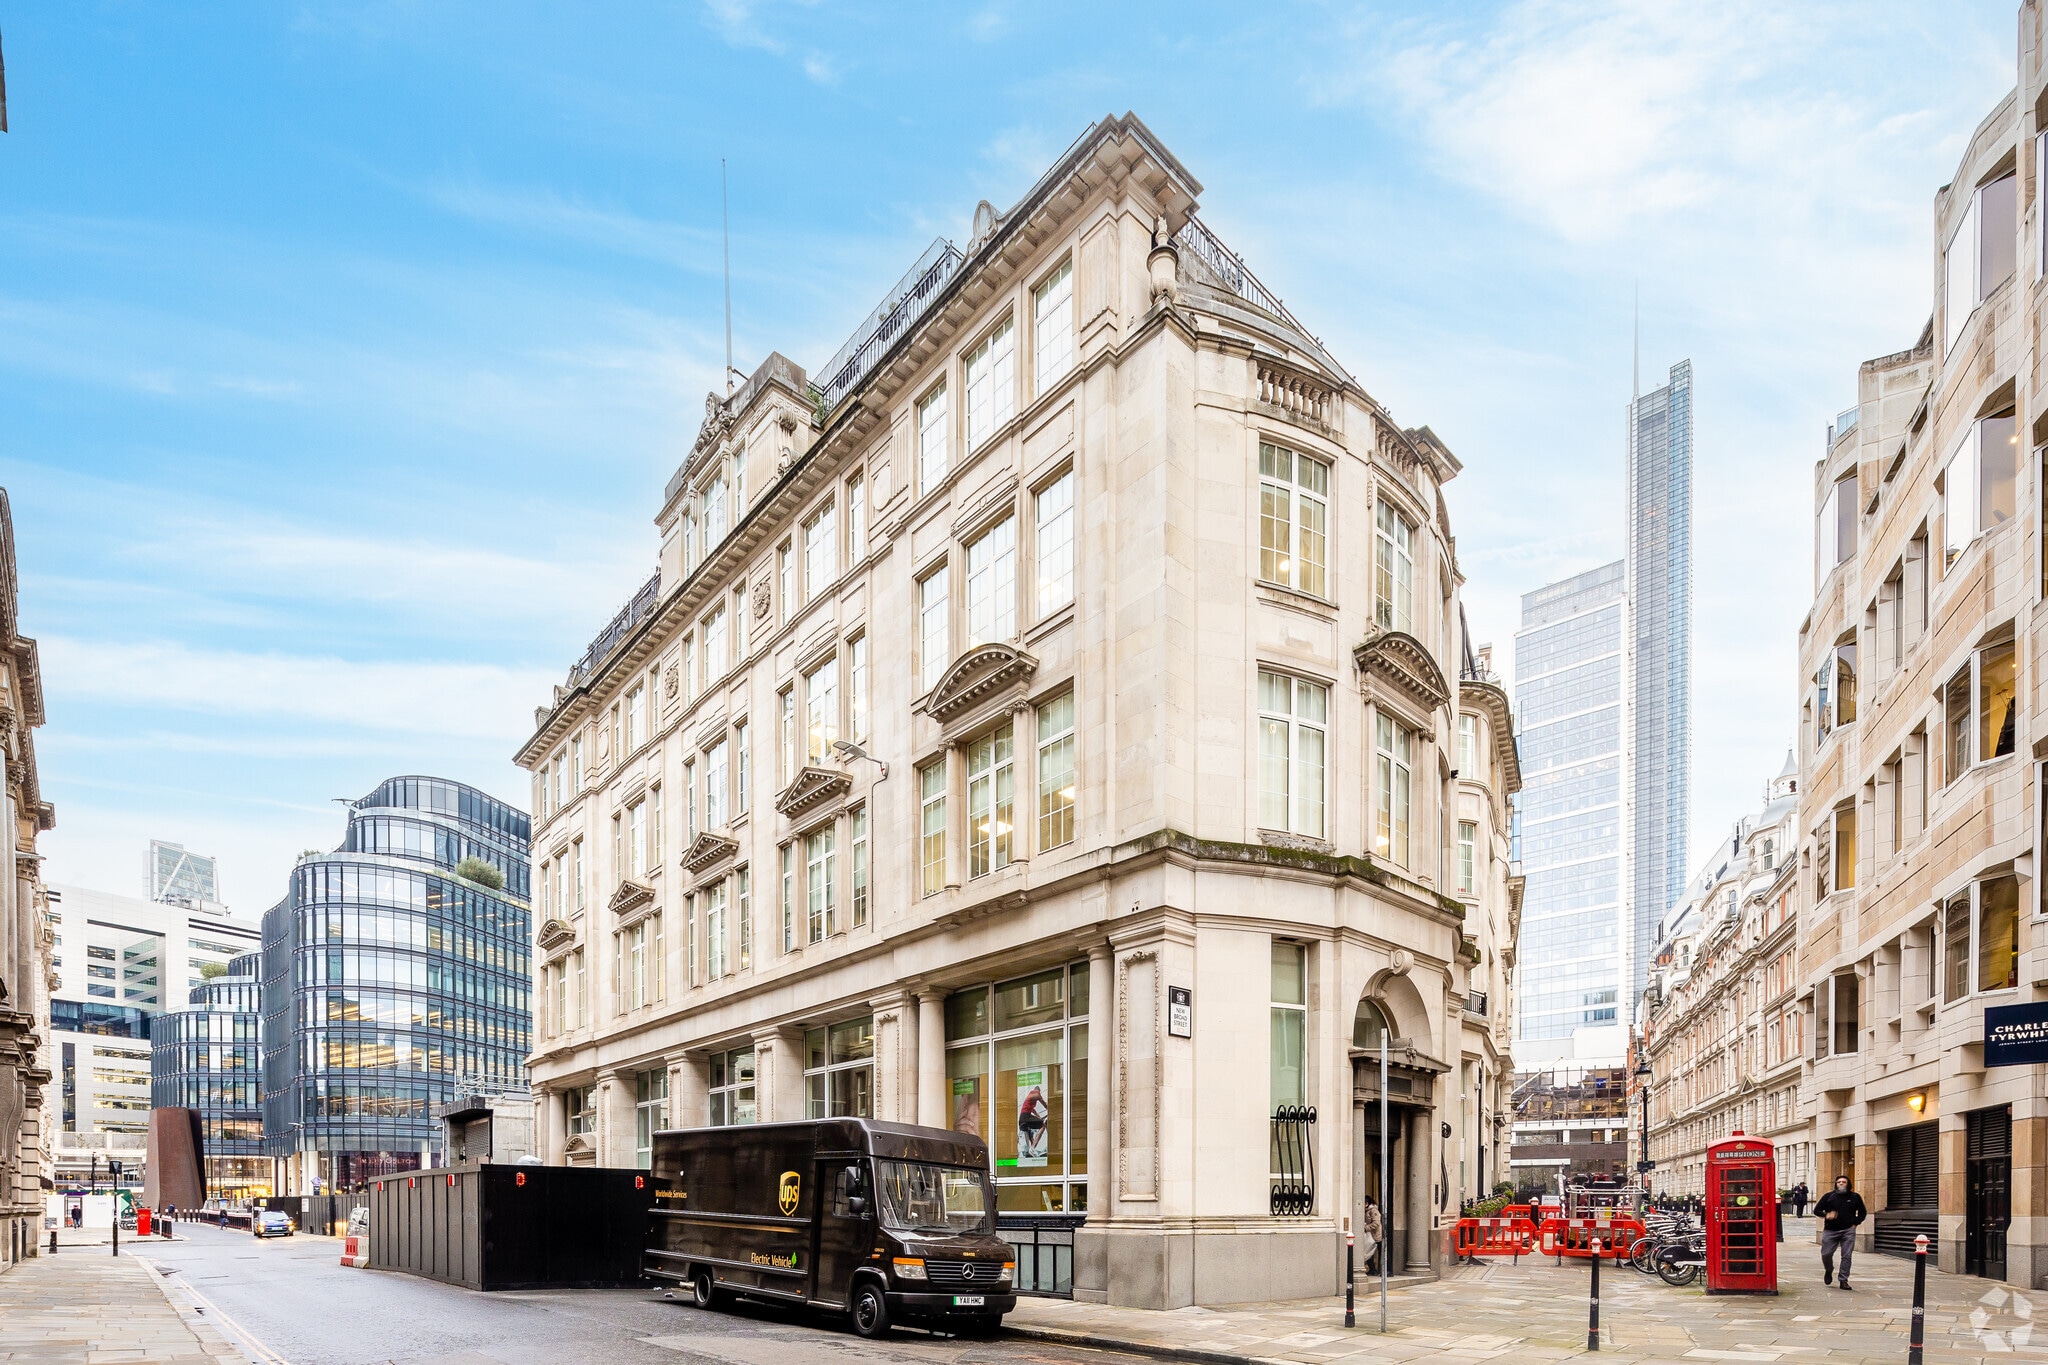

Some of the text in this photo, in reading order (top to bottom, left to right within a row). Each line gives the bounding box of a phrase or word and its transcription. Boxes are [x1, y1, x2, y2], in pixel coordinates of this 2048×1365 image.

[655, 1190, 688, 1199] Worldwide Services
[781, 1185, 798, 1209] ups
[750, 1252, 792, 1268] Electric Vehicle
